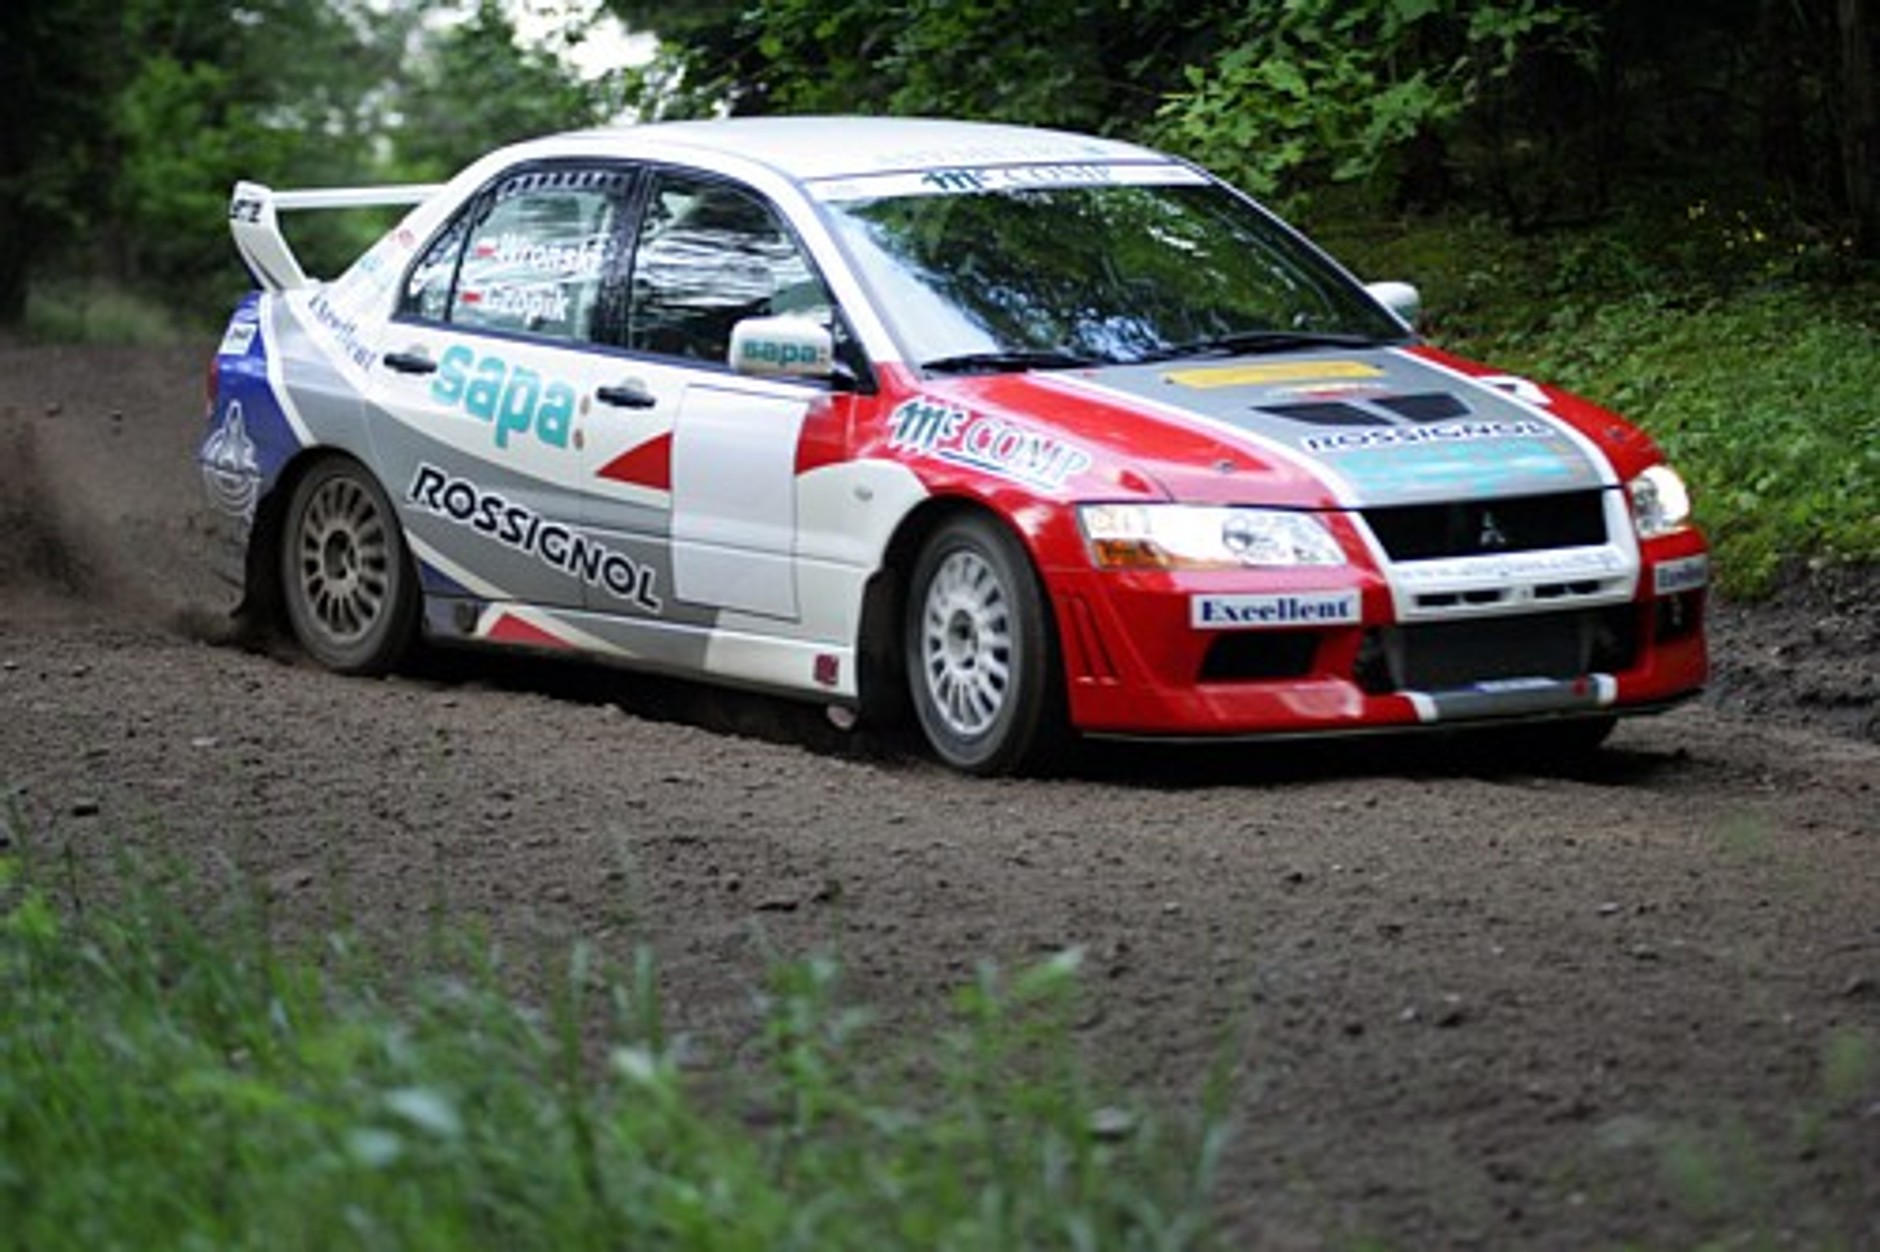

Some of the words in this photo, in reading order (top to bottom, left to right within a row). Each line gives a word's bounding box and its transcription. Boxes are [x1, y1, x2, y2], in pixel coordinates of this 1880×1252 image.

[1306, 421, 1553, 451] ROSSIGNOL
[410, 466, 660, 609] ROSSIGNOL
[1202, 598, 1349, 622] Excellent
